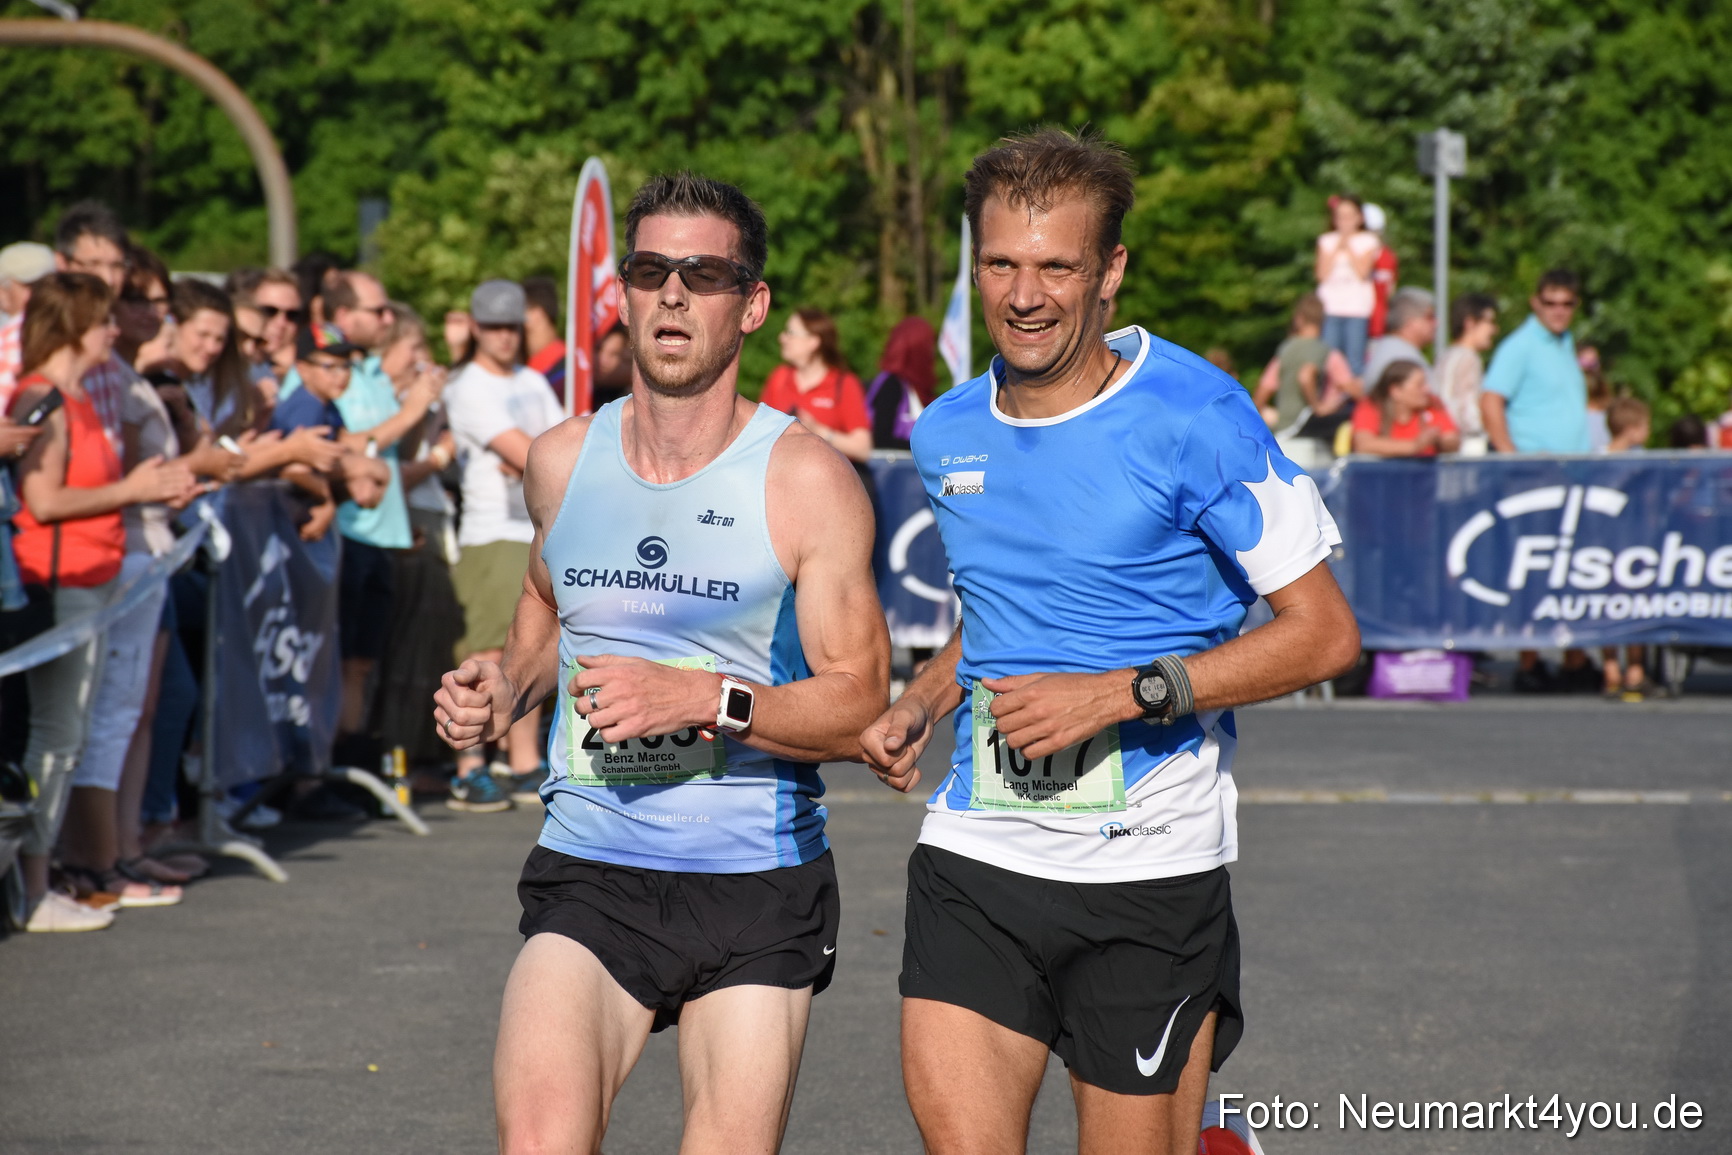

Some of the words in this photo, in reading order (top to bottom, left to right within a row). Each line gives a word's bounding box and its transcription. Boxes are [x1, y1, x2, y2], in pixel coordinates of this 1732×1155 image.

[563, 567, 740, 602] SCHABMÜLLER
[621, 600, 665, 616] TEAM
[604, 753, 634, 764] Benz
[638, 751, 676, 763] Marco
[601, 765, 651, 774] Schabmüller
[654, 763, 681, 772] GmbH
[1003, 779, 1029, 792] Lang
[1032, 780, 1078, 791] Michael
[1017, 793, 1031, 801] IKK
[1033, 793, 1061, 801] classic
